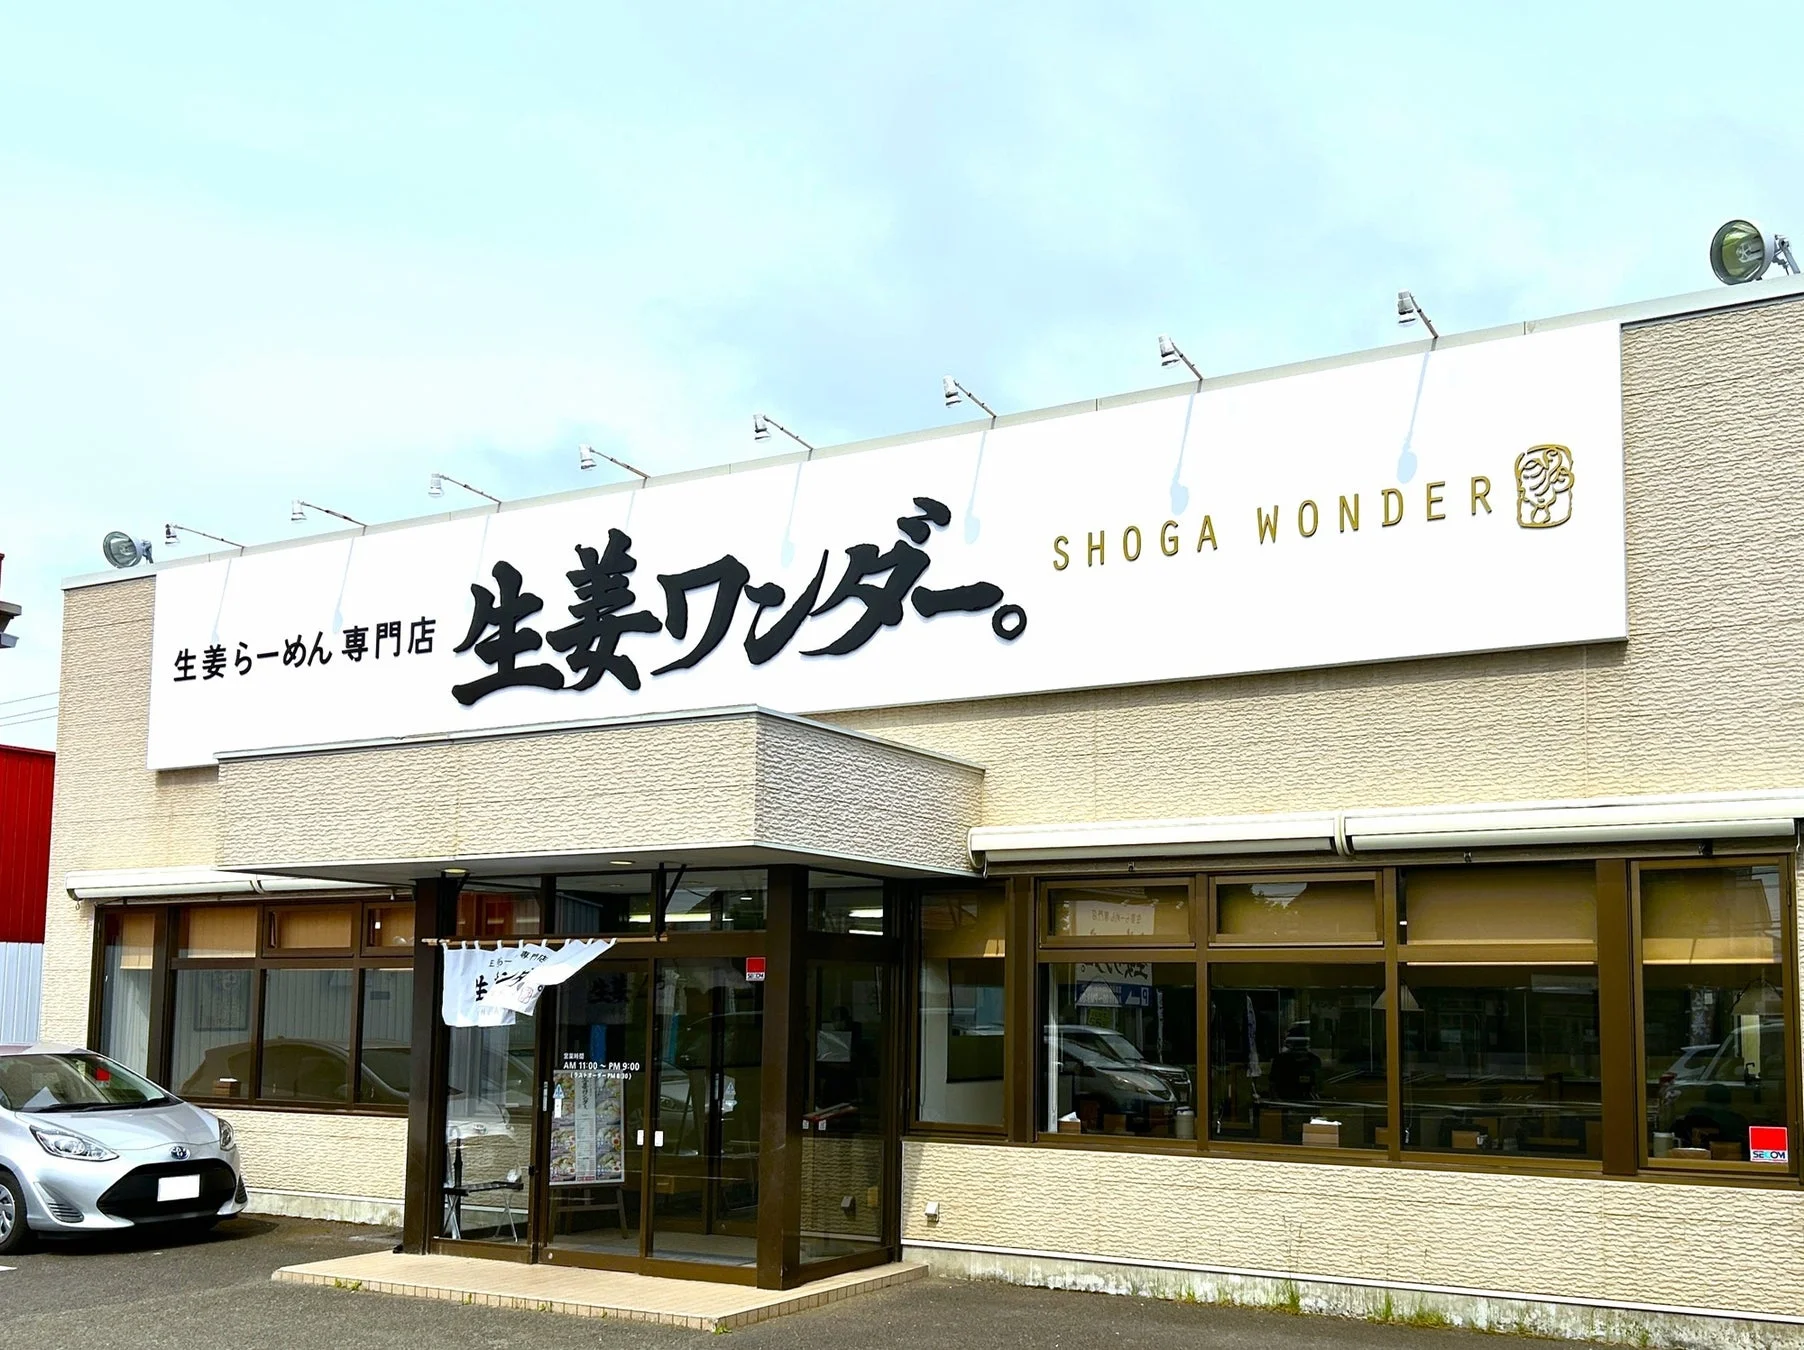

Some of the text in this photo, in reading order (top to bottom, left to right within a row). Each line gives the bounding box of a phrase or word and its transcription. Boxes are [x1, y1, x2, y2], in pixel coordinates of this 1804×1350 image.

[1053, 475, 1493, 570] SHOGA WONDER
[563, 1061, 577, 1070] AM
[579, 1061, 598, 1070] 11:00
[608, 1062, 620, 1071] PM
[622, 1062, 640, 1071] 9:00
[1752, 1150, 1786, 1159] SECOM
